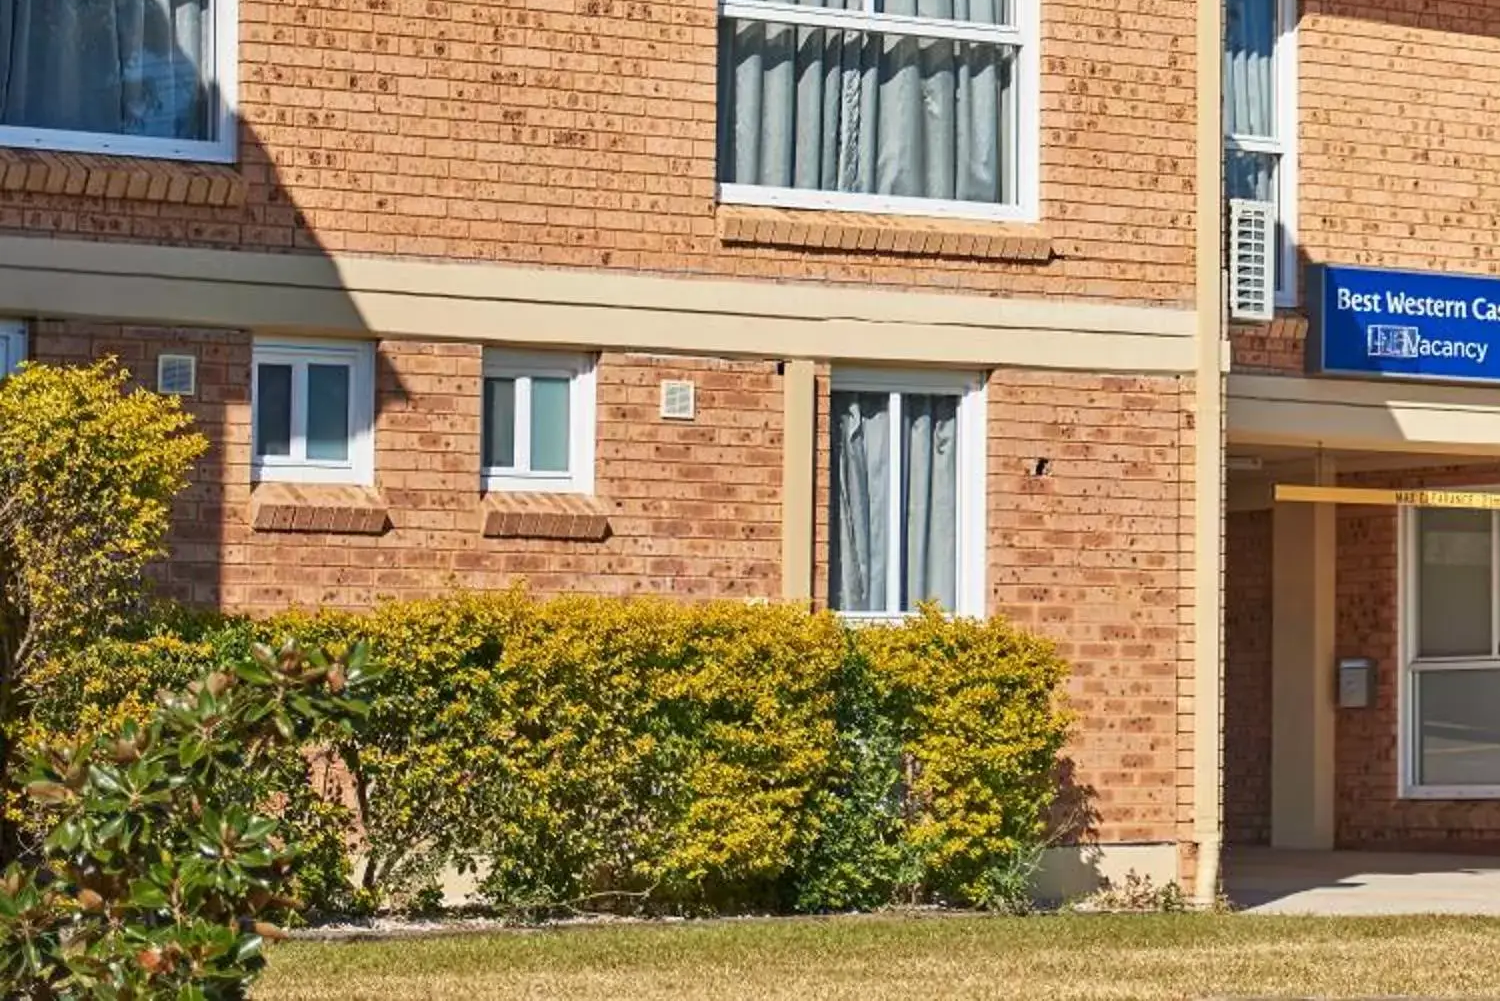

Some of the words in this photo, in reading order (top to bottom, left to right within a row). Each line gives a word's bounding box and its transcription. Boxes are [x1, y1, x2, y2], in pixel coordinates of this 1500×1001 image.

[1337, 287, 1381, 313] Best
[1385, 291, 1467, 319] Western
[1406, 331, 1488, 363] Vacancy
